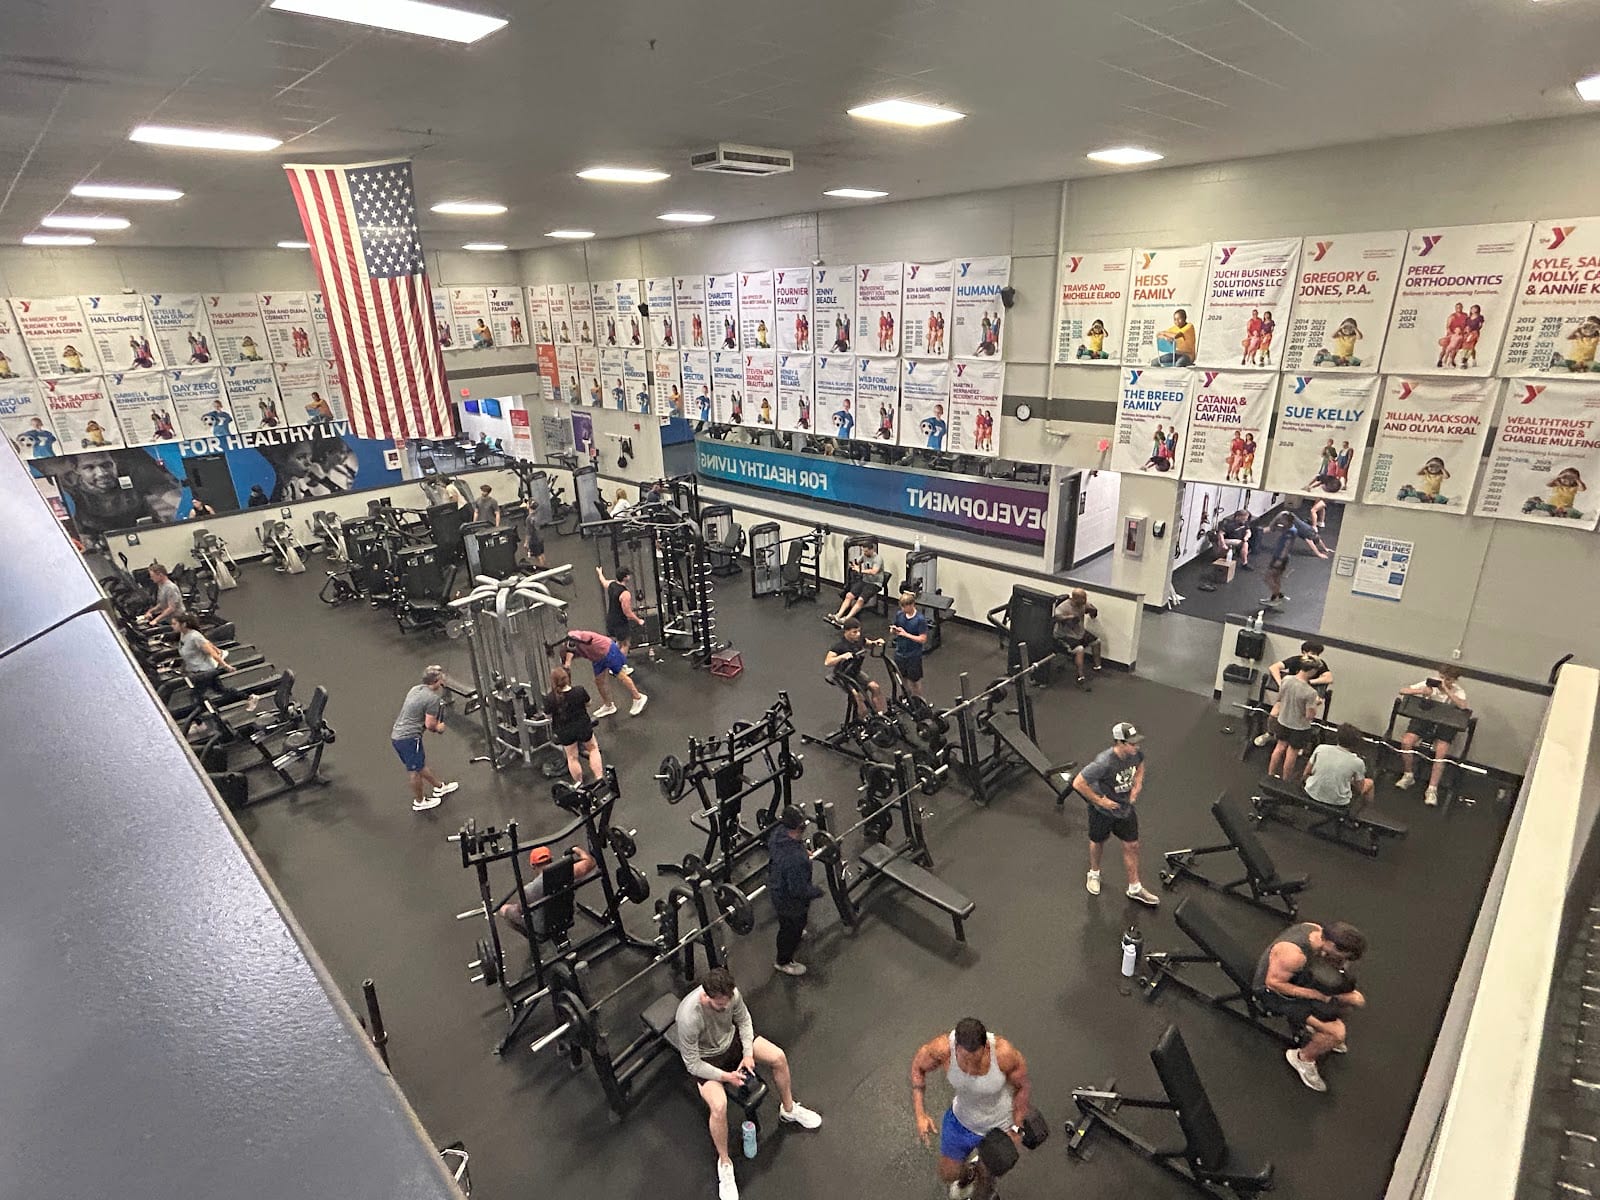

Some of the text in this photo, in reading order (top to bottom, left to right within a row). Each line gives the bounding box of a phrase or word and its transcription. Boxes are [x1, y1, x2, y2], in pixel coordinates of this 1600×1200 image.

[1533, 257, 1600, 270] KYLE, SA
[1214, 269, 1287, 278] JUCHI BUSINESS
[1408, 265, 1445, 275] PEREZ
[1135, 275, 1168, 286] HEISS
[1303, 271, 1379, 283] GREGORY G.
[1406, 275, 1503, 287] ORTHODONTICS
[1529, 271, 1579, 283] MOLLY,
[1213, 280, 1264, 288] SOLUTIONS
[1526, 285, 1536, 295] &
[1539, 284, 1588, 294] ANNIE
[958, 285, 1001, 296] HUMANA
[1134, 288, 1176, 300] FAMILY
[1299, 284, 1371, 297] JONES, P.A.
[172, 384, 191, 392] DAY
[1124, 390, 1183, 402] THE BREED
[1198, 395, 1246, 405] CATANIA &
[1123, 400, 1161, 411] FAMILY
[1196, 404, 1237, 414] CATANIA
[1195, 413, 1241, 423] LAW FIRM
[1285, 406, 1364, 421] SUE KELLY
[1385, 412, 1481, 425] JILLIAN, JACKSON,
[1508, 416, 1594, 428] WEALTHTRUST
[1384, 422, 1477, 435] AND OLIVIA KRAL
[1504, 425, 1585, 438] CONSULTING &
[178, 423, 348, 456] FOR HEALTHY LIV
[1502, 434, 1548, 445] CHARLIE
[1364, 542, 1410, 554] GUIDELINES
